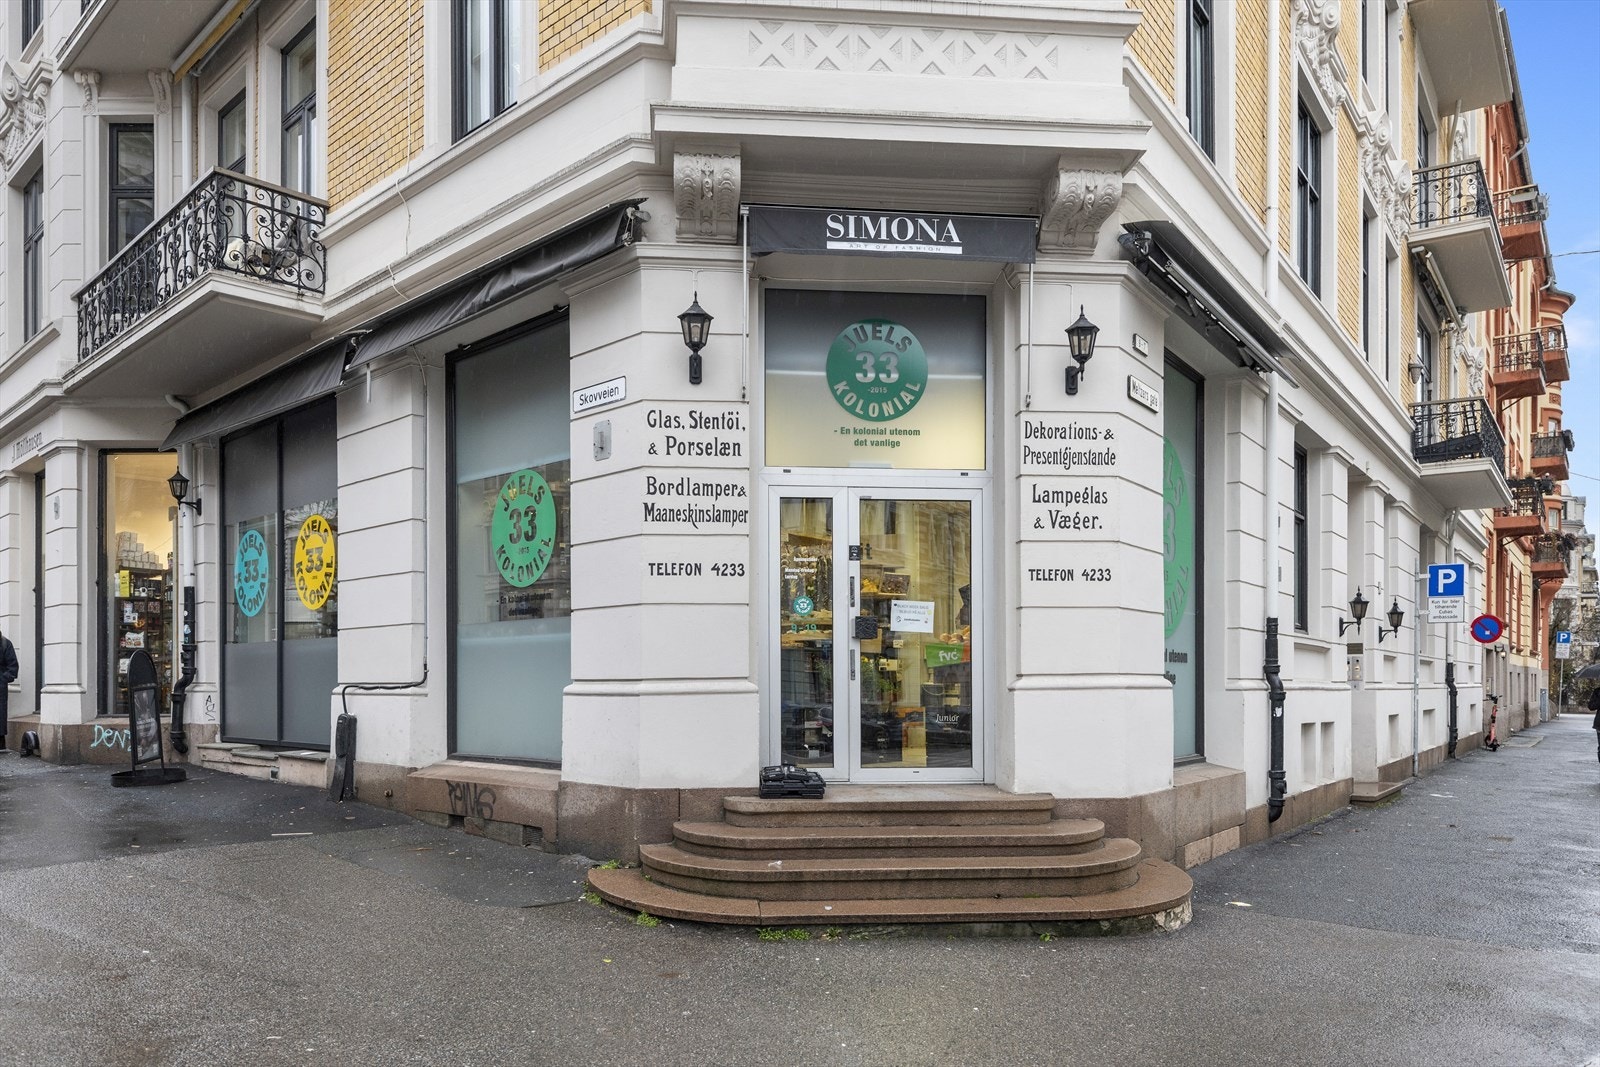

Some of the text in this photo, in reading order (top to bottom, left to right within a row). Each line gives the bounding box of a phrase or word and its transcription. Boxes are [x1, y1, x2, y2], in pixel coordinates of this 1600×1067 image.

[826, 213, 963, 243] SIMONA
[844, 322, 913, 353] JUELS
[855, 350, 899, 383] 33
[579, 386, 620, 406] Skovveien
[833, 380, 921, 418] KOLONIAL
[647, 409, 686, 430] Glas,
[840, 426, 851, 435] En
[853, 426, 887, 436] kolonial
[889, 427, 921, 436] utenom
[648, 435, 742, 457] & Porselæn
[854, 438, 901, 448] det vanlige
[1023, 445, 1116, 470] Presentgjenstande
[501, 474, 546, 512] JUELS
[1032, 483, 1108, 507] Lampeglas
[508, 505, 538, 544] 33
[643, 502, 748, 529] Maaneskinslamper
[1033, 509, 1103, 531] & Væger.
[240, 533, 265, 562] JUELS
[300, 518, 330, 551] JUELS
[243, 558, 260, 584] 33
[305, 546, 324, 574] 33
[496, 536, 552, 583] KOLONIAL
[648, 562, 746, 577] TELEFON 4233
[295, 555, 334, 606] KOLONIAL
[1028, 568, 1112, 582] TELEFON 4233
[1438, 568, 1457, 594] P
[235, 566, 268, 613] KOLONIAL
[1560, 633, 1568, 643] P
